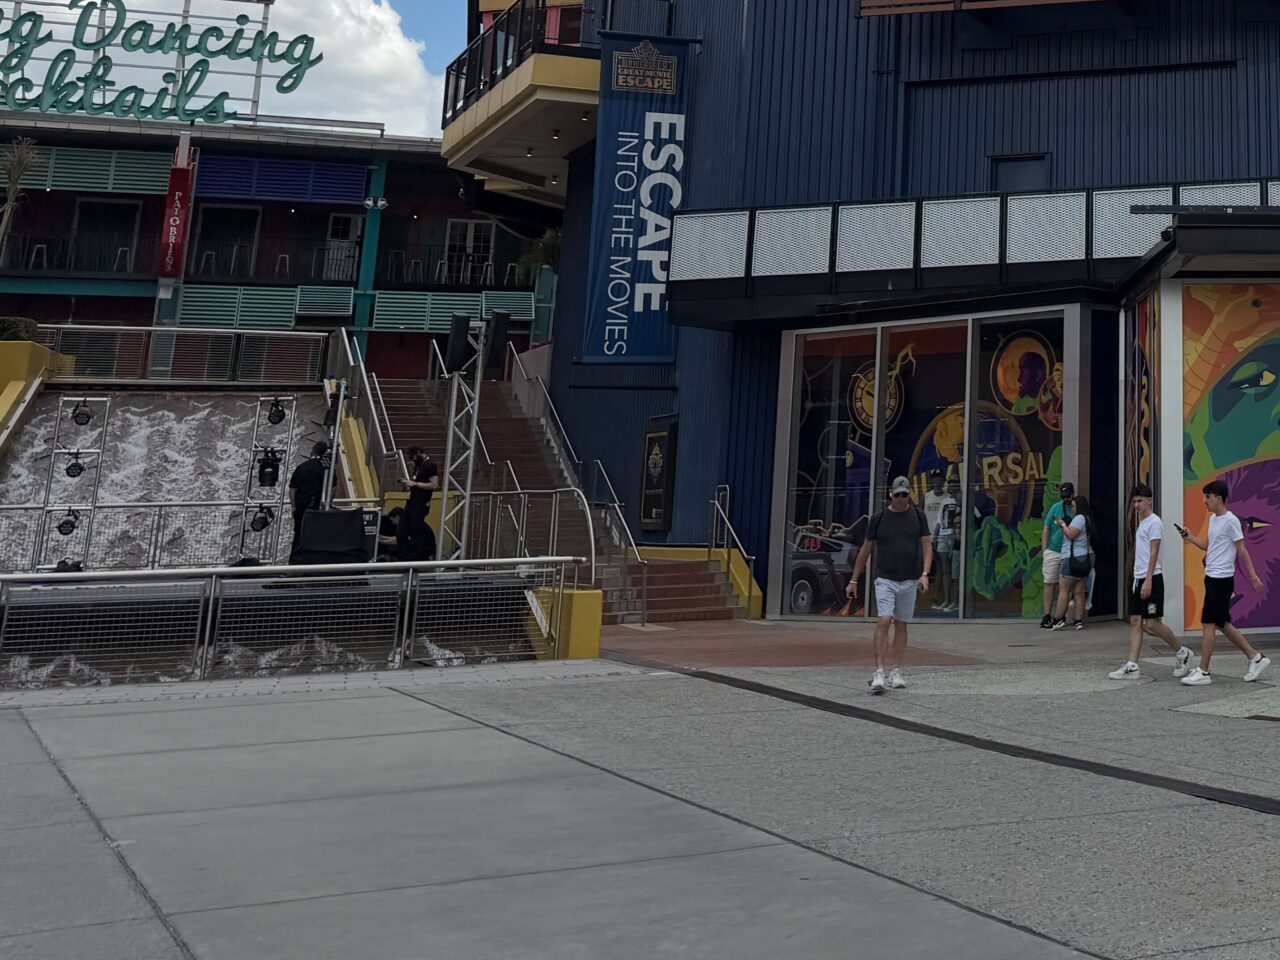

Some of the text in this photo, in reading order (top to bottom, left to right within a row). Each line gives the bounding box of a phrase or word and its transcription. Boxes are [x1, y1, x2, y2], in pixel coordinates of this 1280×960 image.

[0, 8, 53, 74] g
[618, 75, 672, 90] ESCAPE
[604, 130, 640, 356] INTO THE MOVIES
[633, 111, 686, 313] ESCAPE
